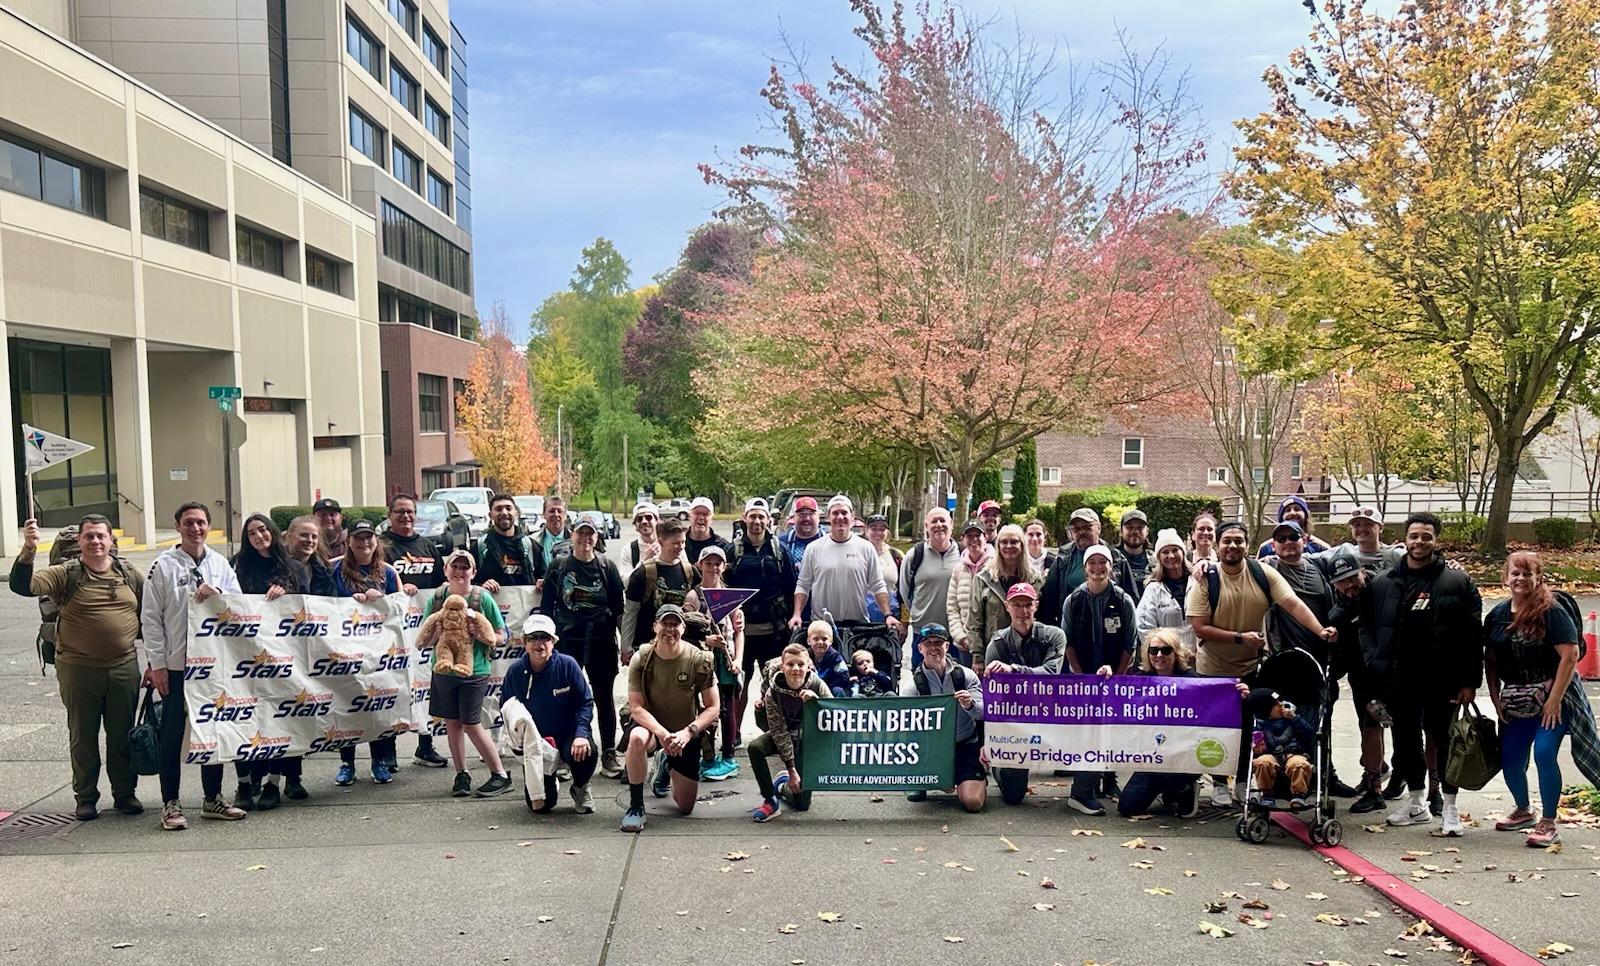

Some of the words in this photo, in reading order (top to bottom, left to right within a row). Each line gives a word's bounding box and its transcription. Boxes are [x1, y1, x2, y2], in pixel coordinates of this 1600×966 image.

[393, 560, 434, 574] Stars
[230, 613, 262, 622] Tacoma
[195, 618, 260, 637] Stars
[276, 619, 328, 637] Stars
[342, 620, 384, 637] Stars
[232, 660, 294, 679] Stars
[307, 658, 363, 677] Stars
[375, 654, 410, 672] Star
[306, 694, 334, 702] Tacoma
[374, 688, 400, 696] Tacoma
[988, 679, 1010, 694] One
[1016, 681, 1028, 694] of
[1033, 681, 1054, 695] the
[1058, 682, 1109, 696] nation's
[1114, 682, 1177, 700] top-rated
[226, 697, 258, 706] Tacoma
[273, 700, 332, 718] Stars
[346, 695, 398, 714] Stars
[988, 700, 1049, 716] children's
[1054, 703, 1118, 720] hospitals.
[1123, 703, 1159, 720] Right
[1164, 704, 1198, 718] here.
[196, 704, 256, 724] Stars
[817, 709, 882, 732] GREEN
[886, 707, 946, 732] BERET
[260, 736, 292, 746] Tacoma
[989, 735, 1028, 744] MultiCare
[230, 744, 290, 762] Stars
[840, 742, 920, 765] FITNESS
[990, 748, 1028, 764] Mary
[1030, 748, 1082, 766] Bridge
[1084, 750, 1164, 764] Children's
[818, 776, 829, 784] WE
[848, 776, 863, 784] THE
[863, 776, 906, 784] ADVENTURE
[907, 775, 939, 784] SEEKERS
